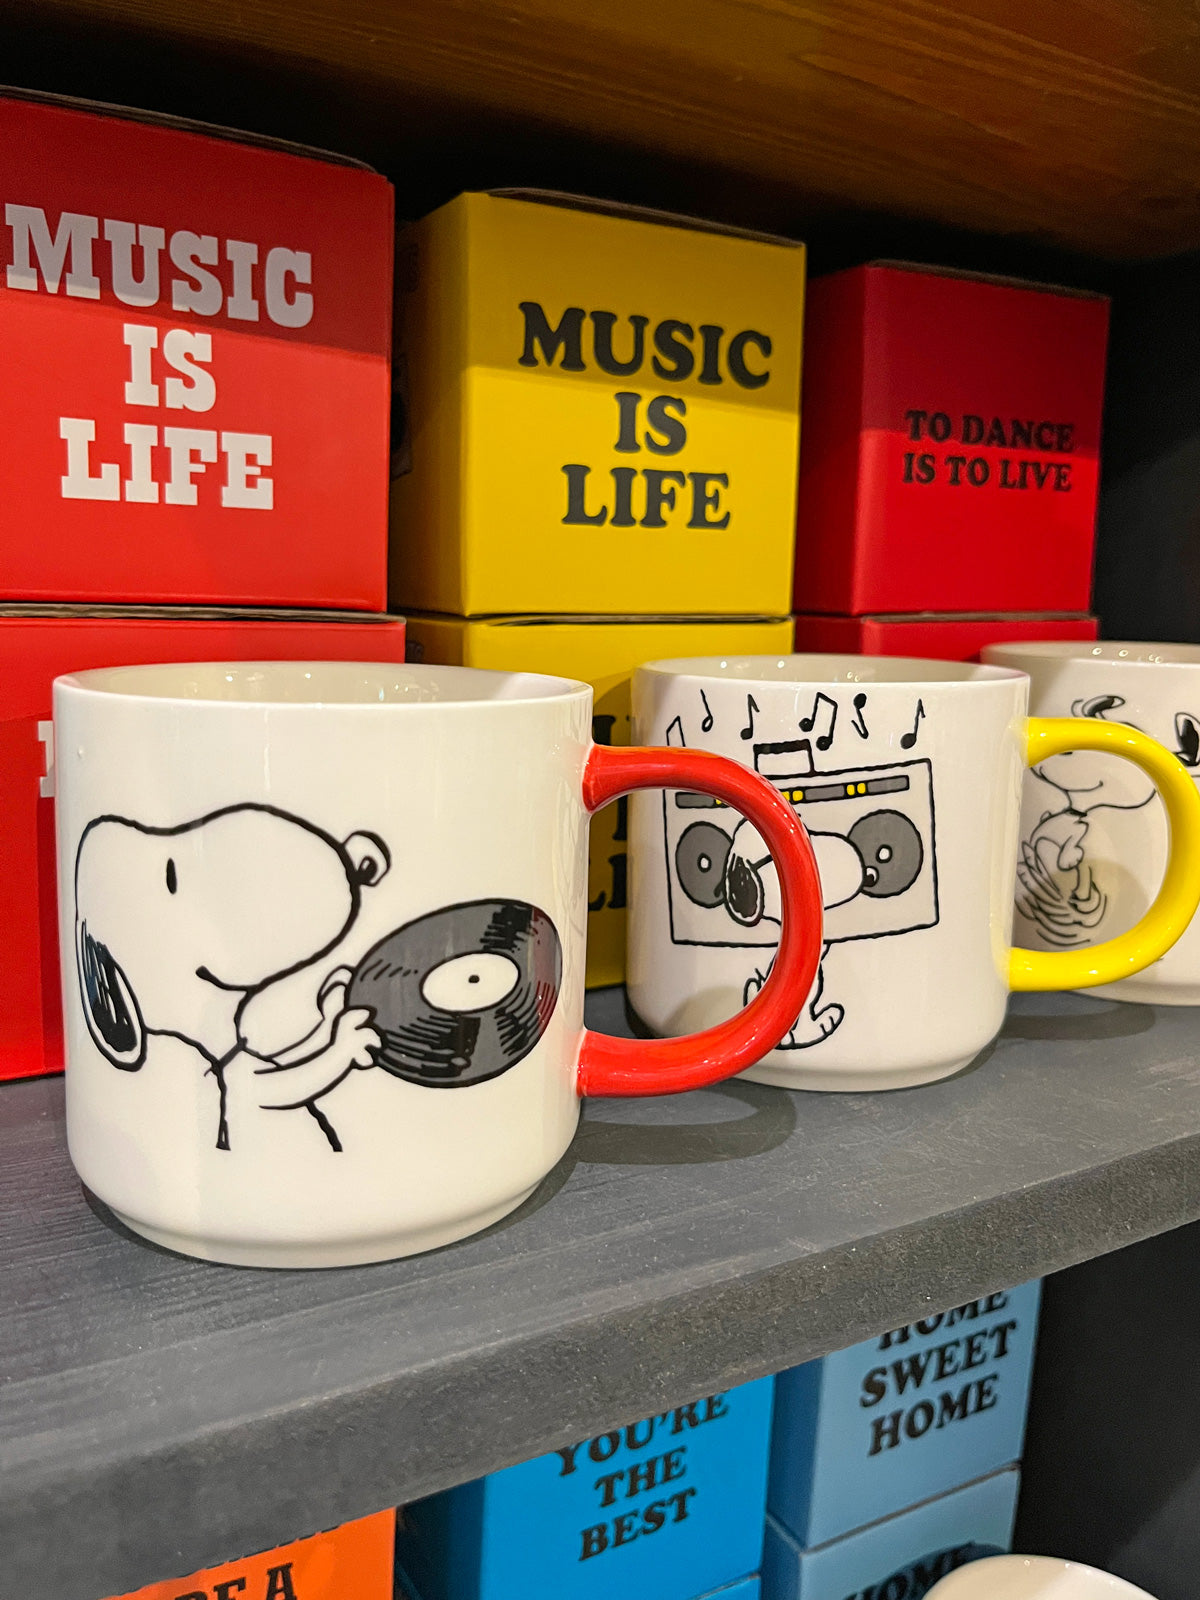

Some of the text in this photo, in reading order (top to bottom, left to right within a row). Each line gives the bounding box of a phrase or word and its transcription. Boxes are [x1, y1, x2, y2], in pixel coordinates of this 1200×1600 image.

[5, 203, 314, 328] MUSIC
[124, 323, 216, 412] IS
[518, 301, 772, 389] MUSIC
[60, 417, 273, 510] LIFE
[614, 391, 687, 456] IS
[905, 410, 1074, 453] TO DANCE
[560, 464, 730, 530] LIFE
[903, 453, 1072, 492] IS TO LIVE
[860, 1320, 1016, 1408] SWEET
[554, 1389, 730, 1476] YOU'RE
[868, 1374, 998, 1456] HOME
[594, 1445, 687, 1508] THE
[578, 1487, 696, 1561] BEST
